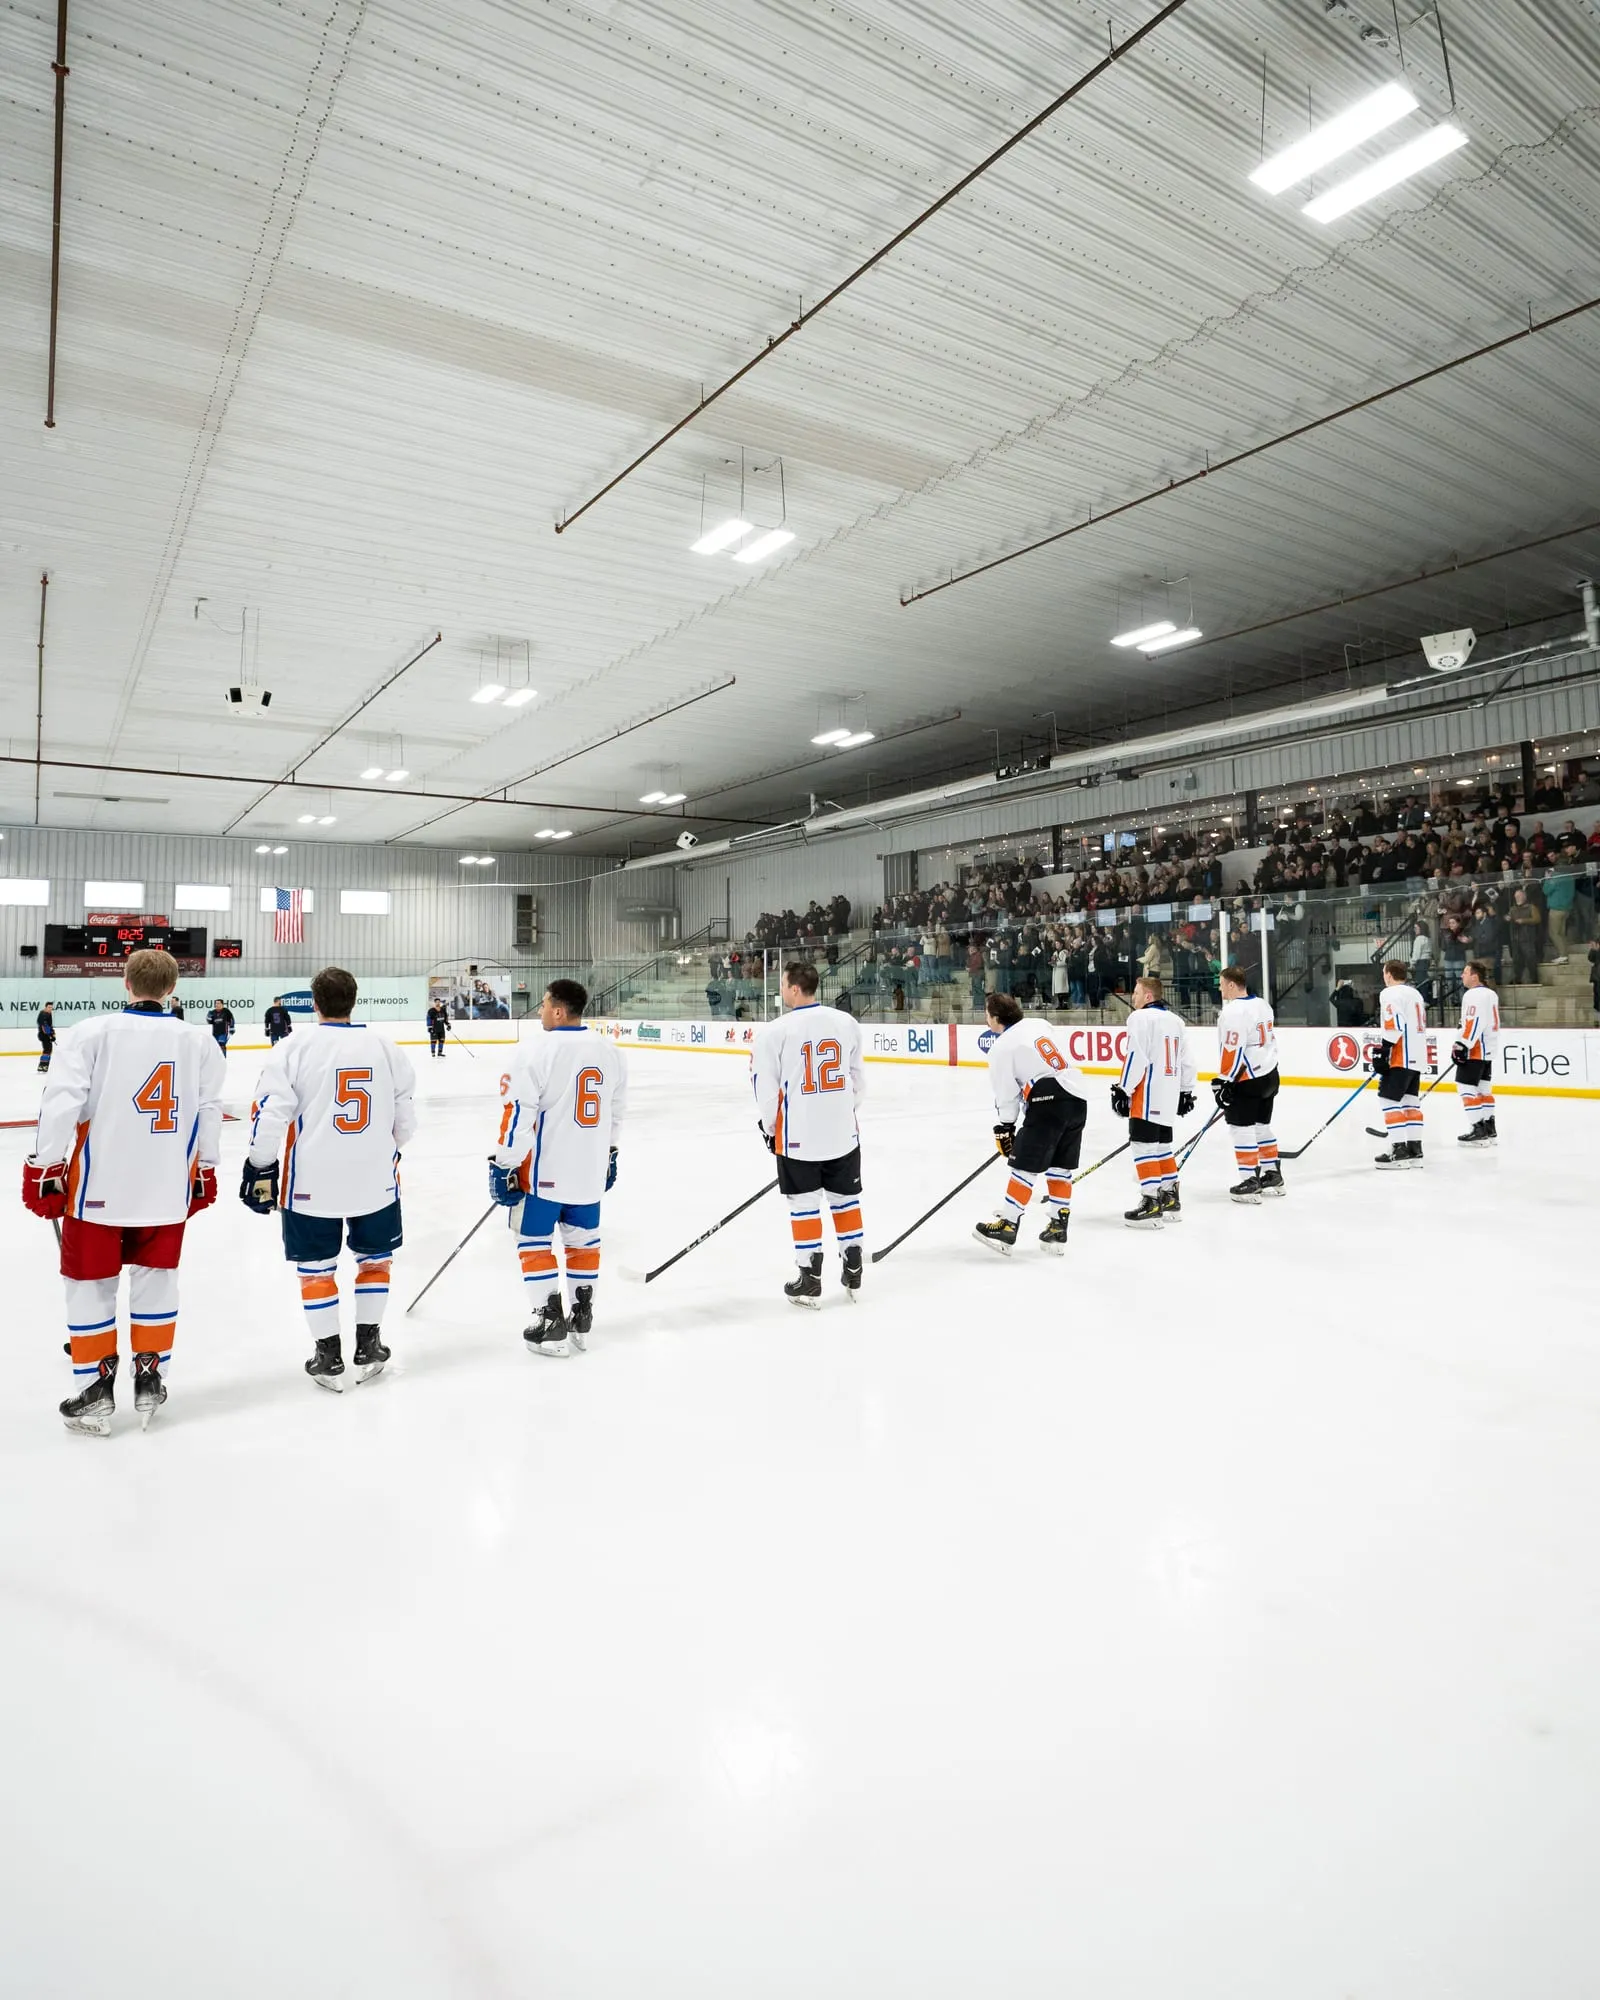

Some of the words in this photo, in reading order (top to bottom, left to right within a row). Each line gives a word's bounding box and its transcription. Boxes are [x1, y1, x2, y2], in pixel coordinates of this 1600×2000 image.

[98, 943, 107, 955] 0
[10, 1001, 40, 1011] NEW
[53, 1000, 96, 1010] ANATA
[101, 1000, 128, 1010] NOR
[163, 999, 255, 1009] EIHBOUHOOD
[357, 997, 409, 1005] ORTHWOODS
[690, 1024, 706, 1043] Bell
[873, 1032, 898, 1052] Fibe
[908, 1029, 934, 1053] Bell
[1069, 1030, 1128, 1062] CIBC
[1225, 1030, 1239, 1046] 13
[800, 1038, 846, 1095] 12
[1033, 1035, 1069, 1072] 8
[1503, 1045, 1570, 1076] Fibe
[132, 1061, 179, 1133] 4
[333, 1067, 373, 1134] 5
[573, 1066, 604, 1128] 6
